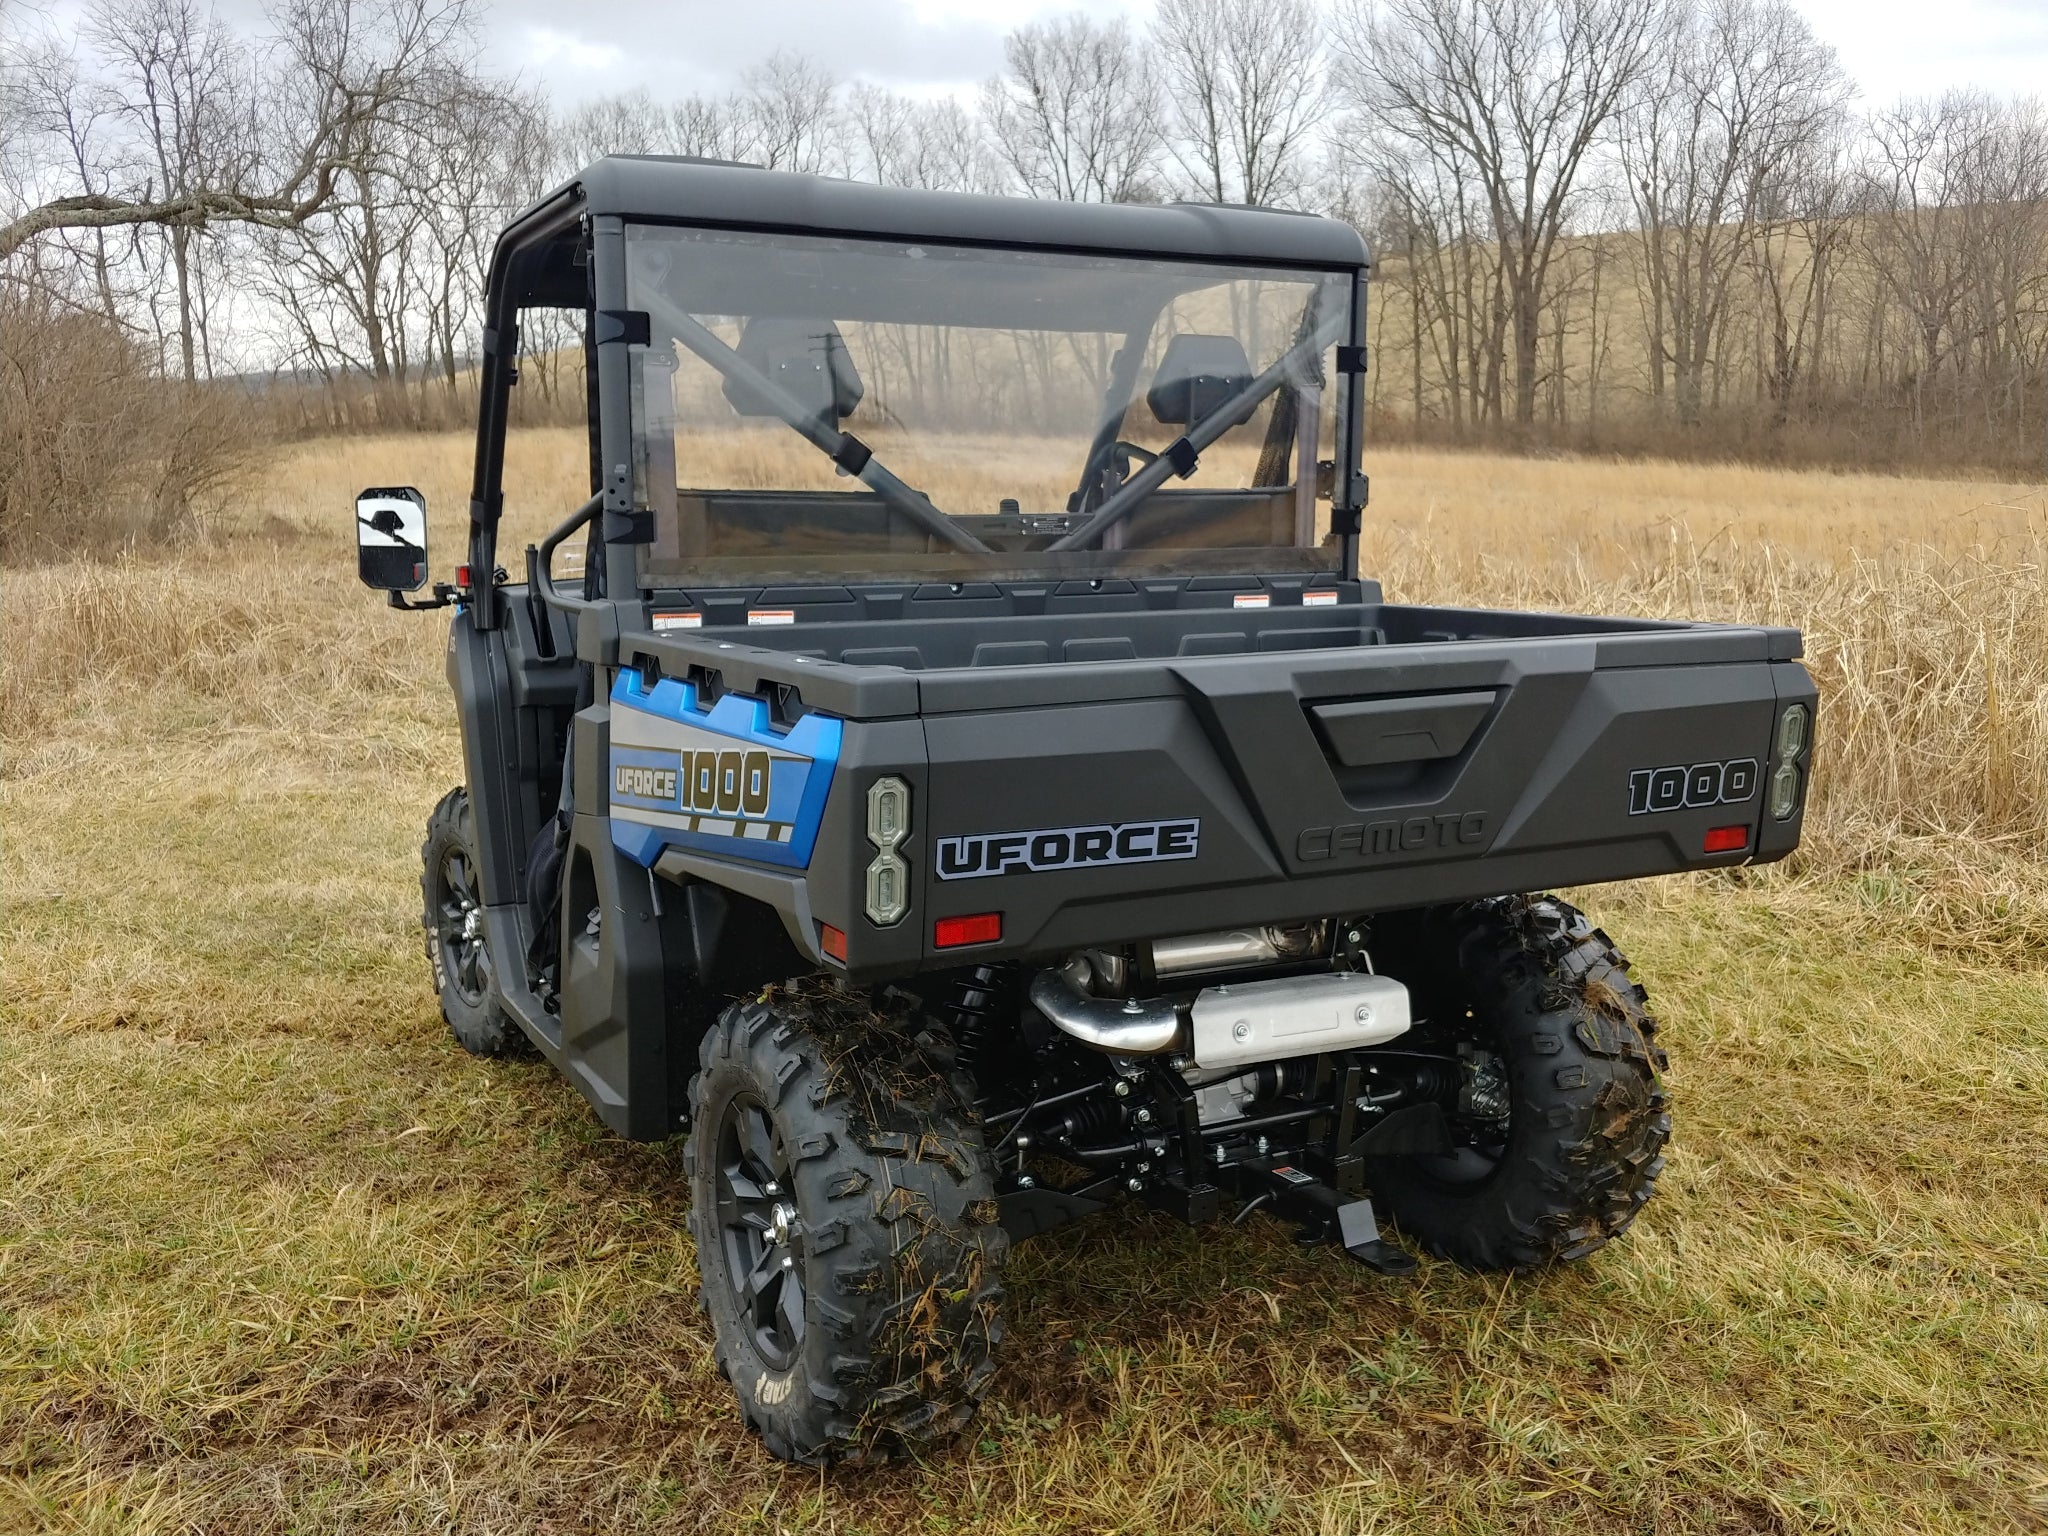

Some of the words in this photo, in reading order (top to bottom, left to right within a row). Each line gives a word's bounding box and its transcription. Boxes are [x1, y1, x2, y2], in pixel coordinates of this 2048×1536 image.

[616, 766, 677, 799] UFORCE
[681, 748, 771, 818] 1000
[1629, 758, 1759, 815] 1000
[936, 818, 1200, 880] UFORCE
[1298, 810, 1489, 861] CFMOTO
